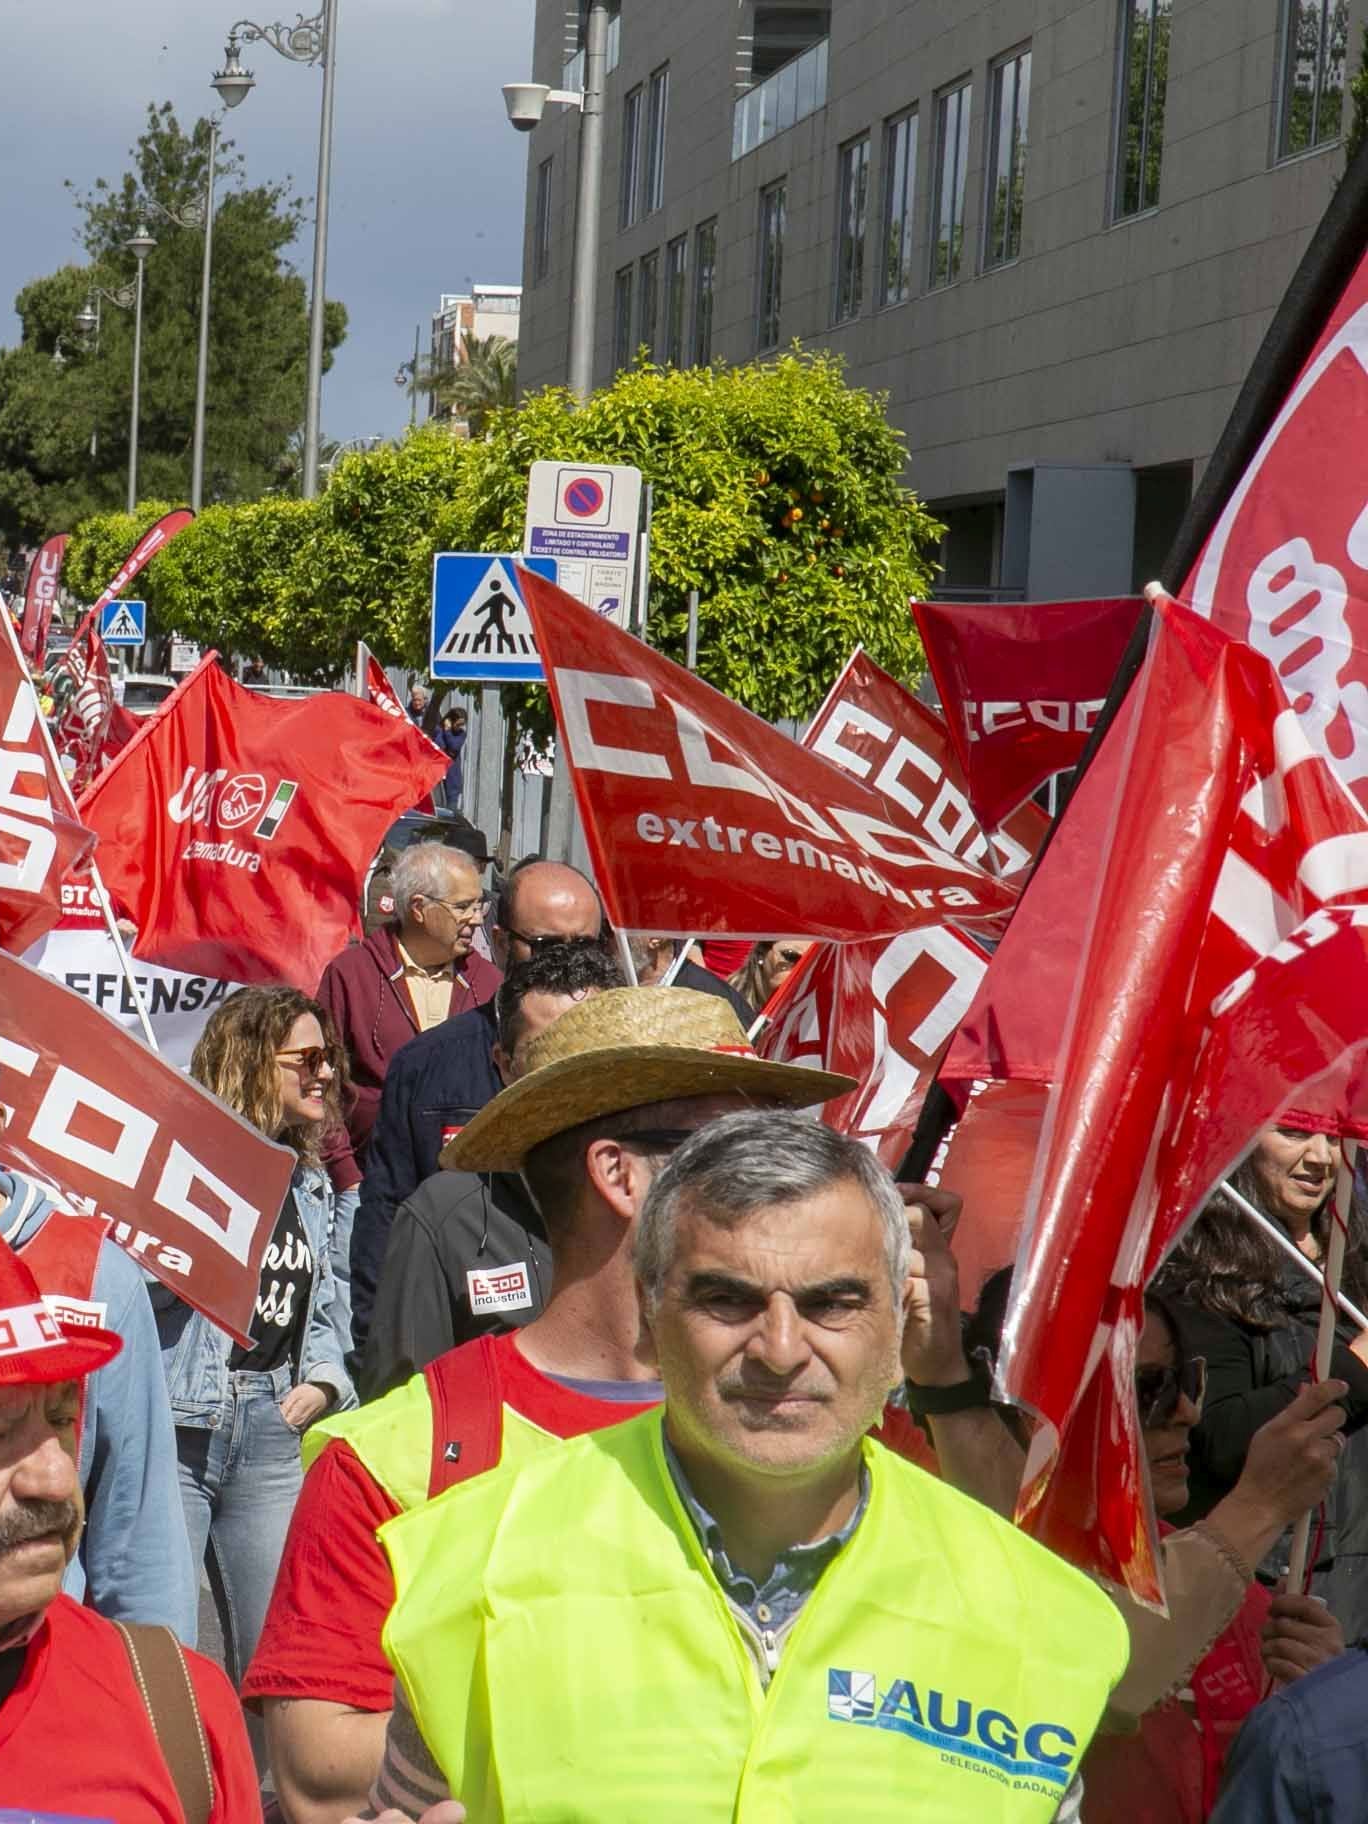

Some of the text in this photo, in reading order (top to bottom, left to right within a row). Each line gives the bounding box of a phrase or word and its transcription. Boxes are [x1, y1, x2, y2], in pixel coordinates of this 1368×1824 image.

[636, 811, 980, 911] extremadura
[474, 1291, 527, 1306] industria
[878, 1679, 1077, 1767] AUGC
